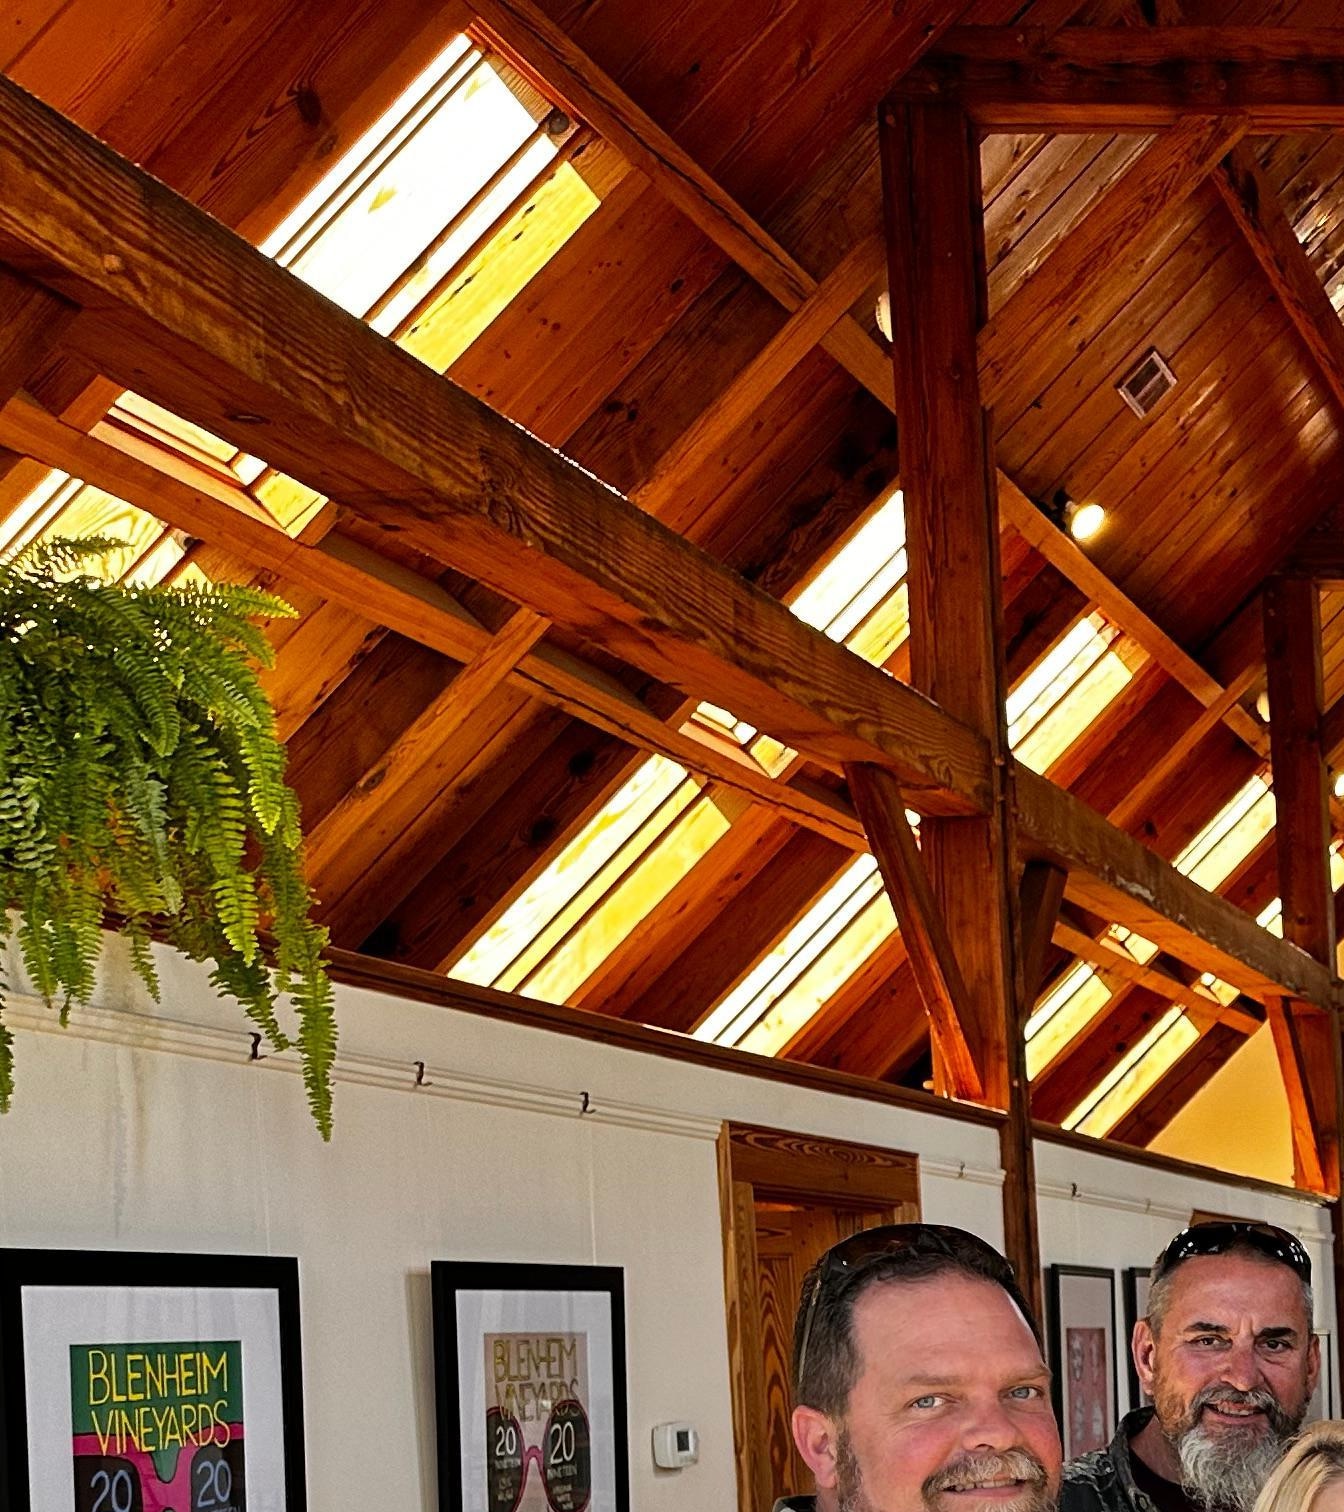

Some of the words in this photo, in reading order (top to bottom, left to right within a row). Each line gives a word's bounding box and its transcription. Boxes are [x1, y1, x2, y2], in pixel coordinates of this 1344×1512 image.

[88, 1350, 228, 1405] BLENHEIM
[91, 1400, 231, 1456] VINEYARDS
[496, 1425, 516, 1456] 20
[550, 1421, 575, 1465] 20
[196, 1459, 232, 1508] 20
